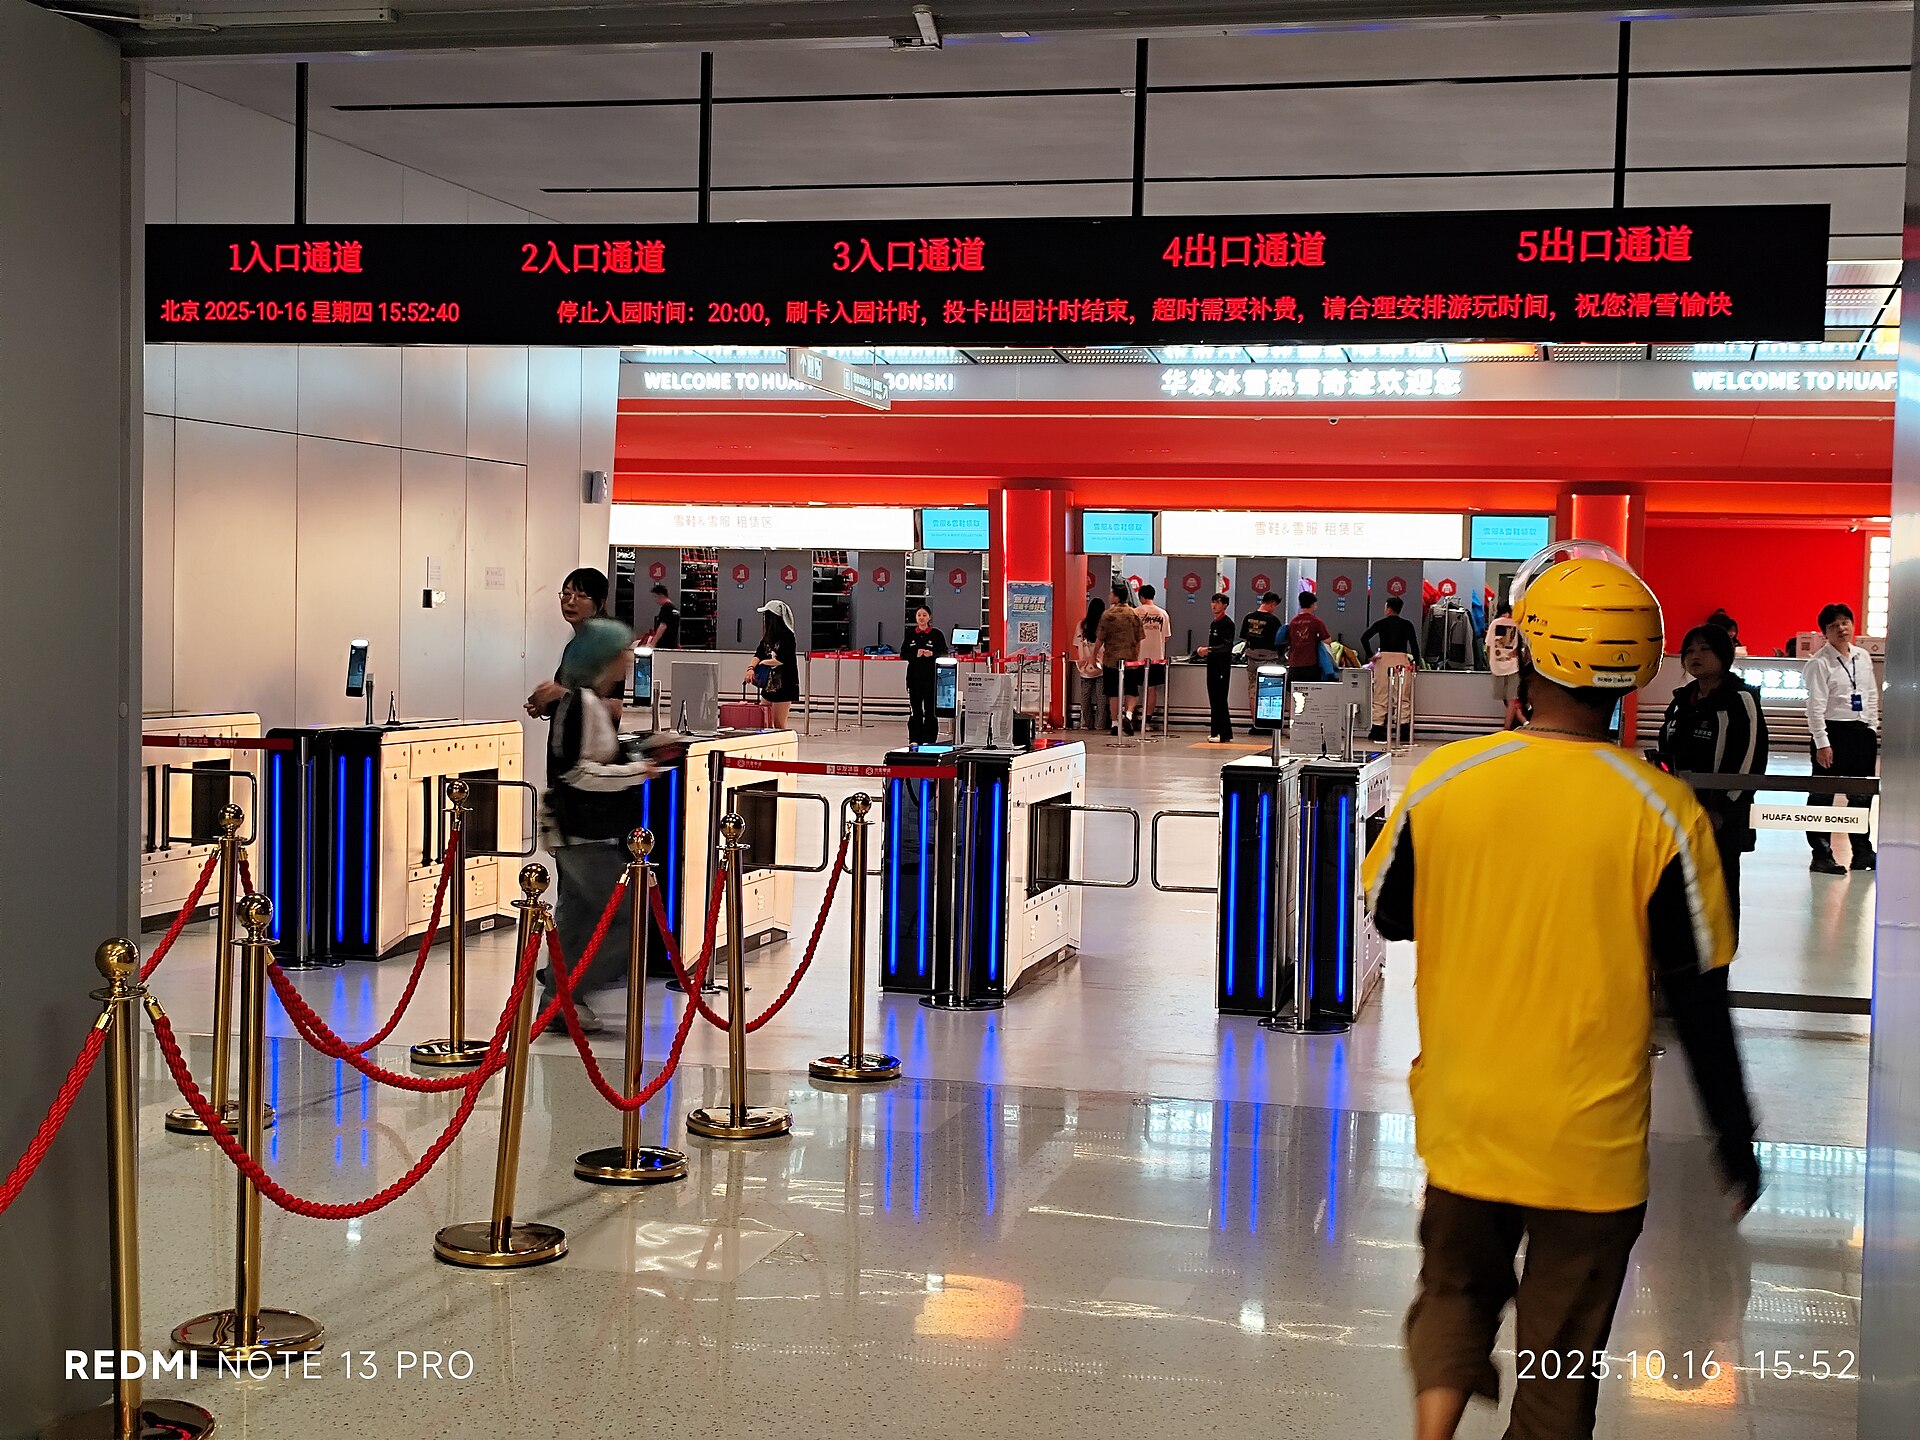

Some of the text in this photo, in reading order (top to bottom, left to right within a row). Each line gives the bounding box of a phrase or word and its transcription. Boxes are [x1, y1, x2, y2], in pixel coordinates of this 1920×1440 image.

[229, 240, 364, 274] 1入口通道
[521, 239, 666, 274] 2入口通道
[832, 236, 986, 273] 3入口通道
[1162, 231, 1327, 269] 4出口通道
[1516, 224, 1694, 264] 5出口通道
[160, 299, 460, 324] 北京 2025-10-16 星期四 15:52:40
[644, 372, 732, 392] WELCOME
[734, 372, 760, 391] TO
[1160, 367, 1463, 397] 华发冰雪热雪奇迹欢迎您
[1692, 371, 1801, 391] WELCOME
[1803, 371, 1835, 391] TO
[1254, 521, 1365, 536] 雪鞋&雪服 租赁区
[1761, 813, 1859, 824] HUAFA SNOW BONSKI
